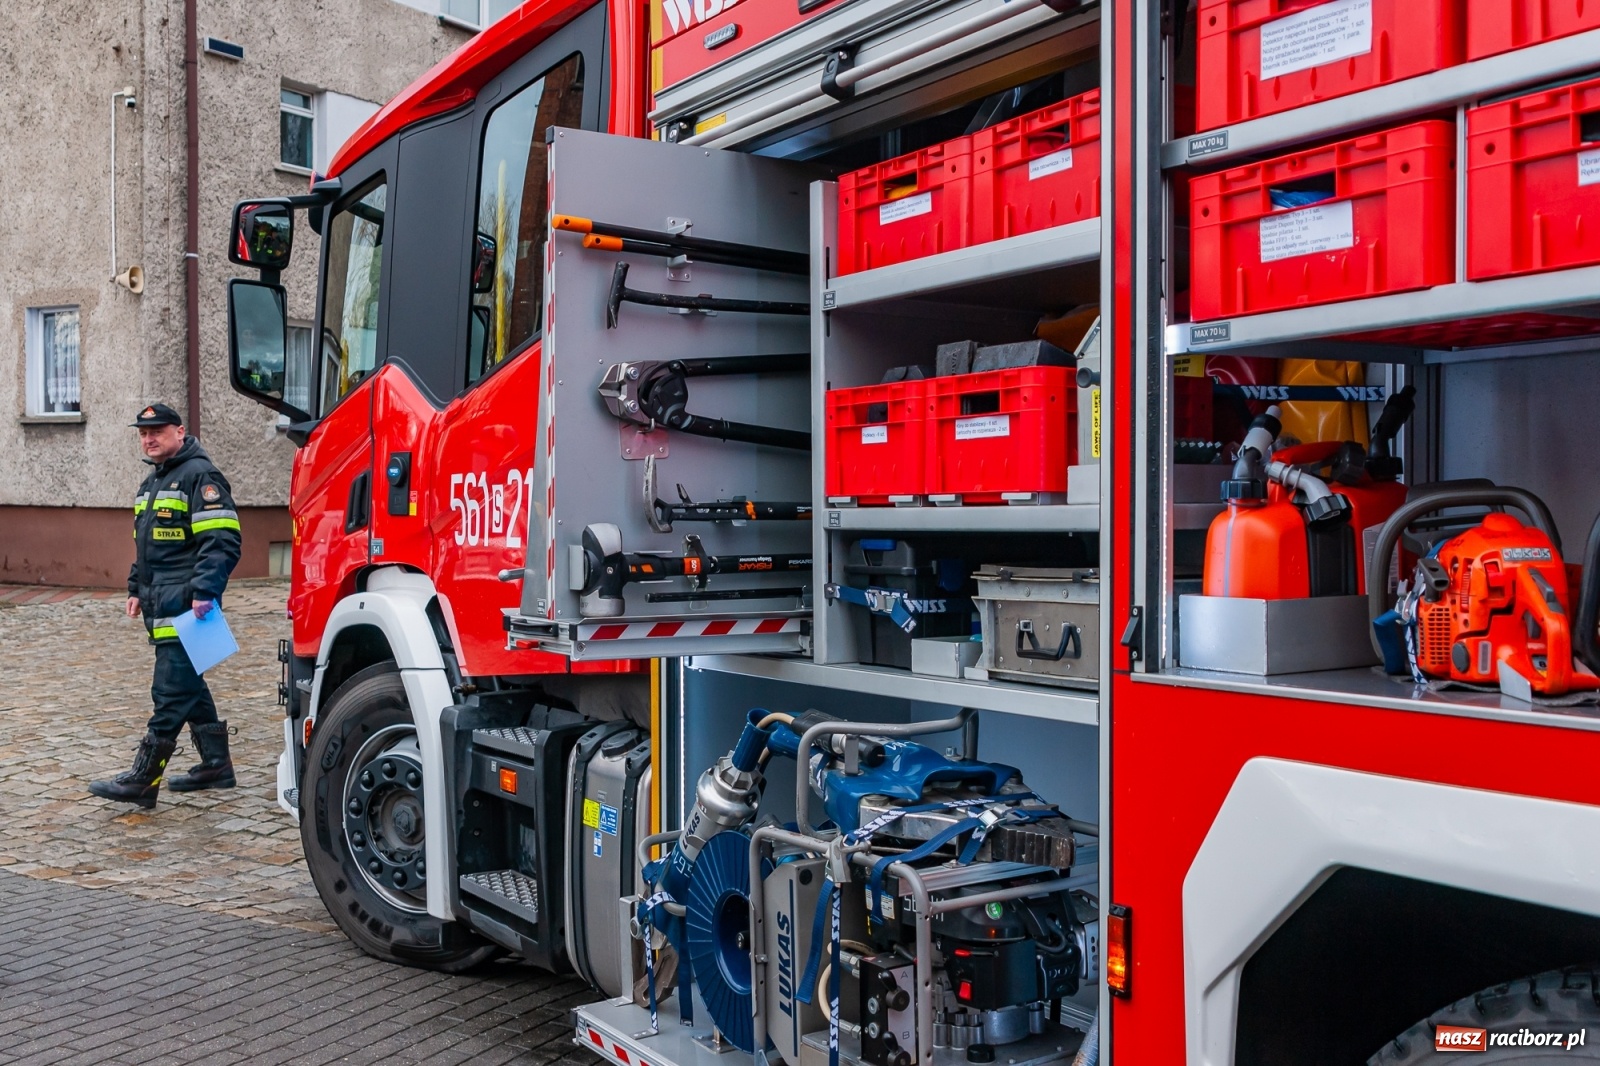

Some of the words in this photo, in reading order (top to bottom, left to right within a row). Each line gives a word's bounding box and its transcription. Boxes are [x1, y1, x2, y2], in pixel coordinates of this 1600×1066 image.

[1286, 21, 1308, 32] specjalne
[1263, 36, 1284, 46] Detektor
[1318, 22, 1330, 30] Stick
[1316, 27, 1346, 40] przewodów
[1263, 56, 1274, 64] Buty
[1192, 140, 1206, 150] MAX
[1208, 138, 1215, 147] 70
[1217, 137, 1224, 146] kg
[1194, 329, 1208, 338] MAX
[1210, 328, 1217, 336] 70
[1219, 327, 1226, 336] kg
[1240, 386, 1290, 400] WISS
[1094, 416, 1099, 428] OF
[450, 471, 489, 547] 561
[903, 599, 947, 613] WISS
[682, 811, 701, 851] LUKAS
[777, 910, 792, 1019] LUKAS
